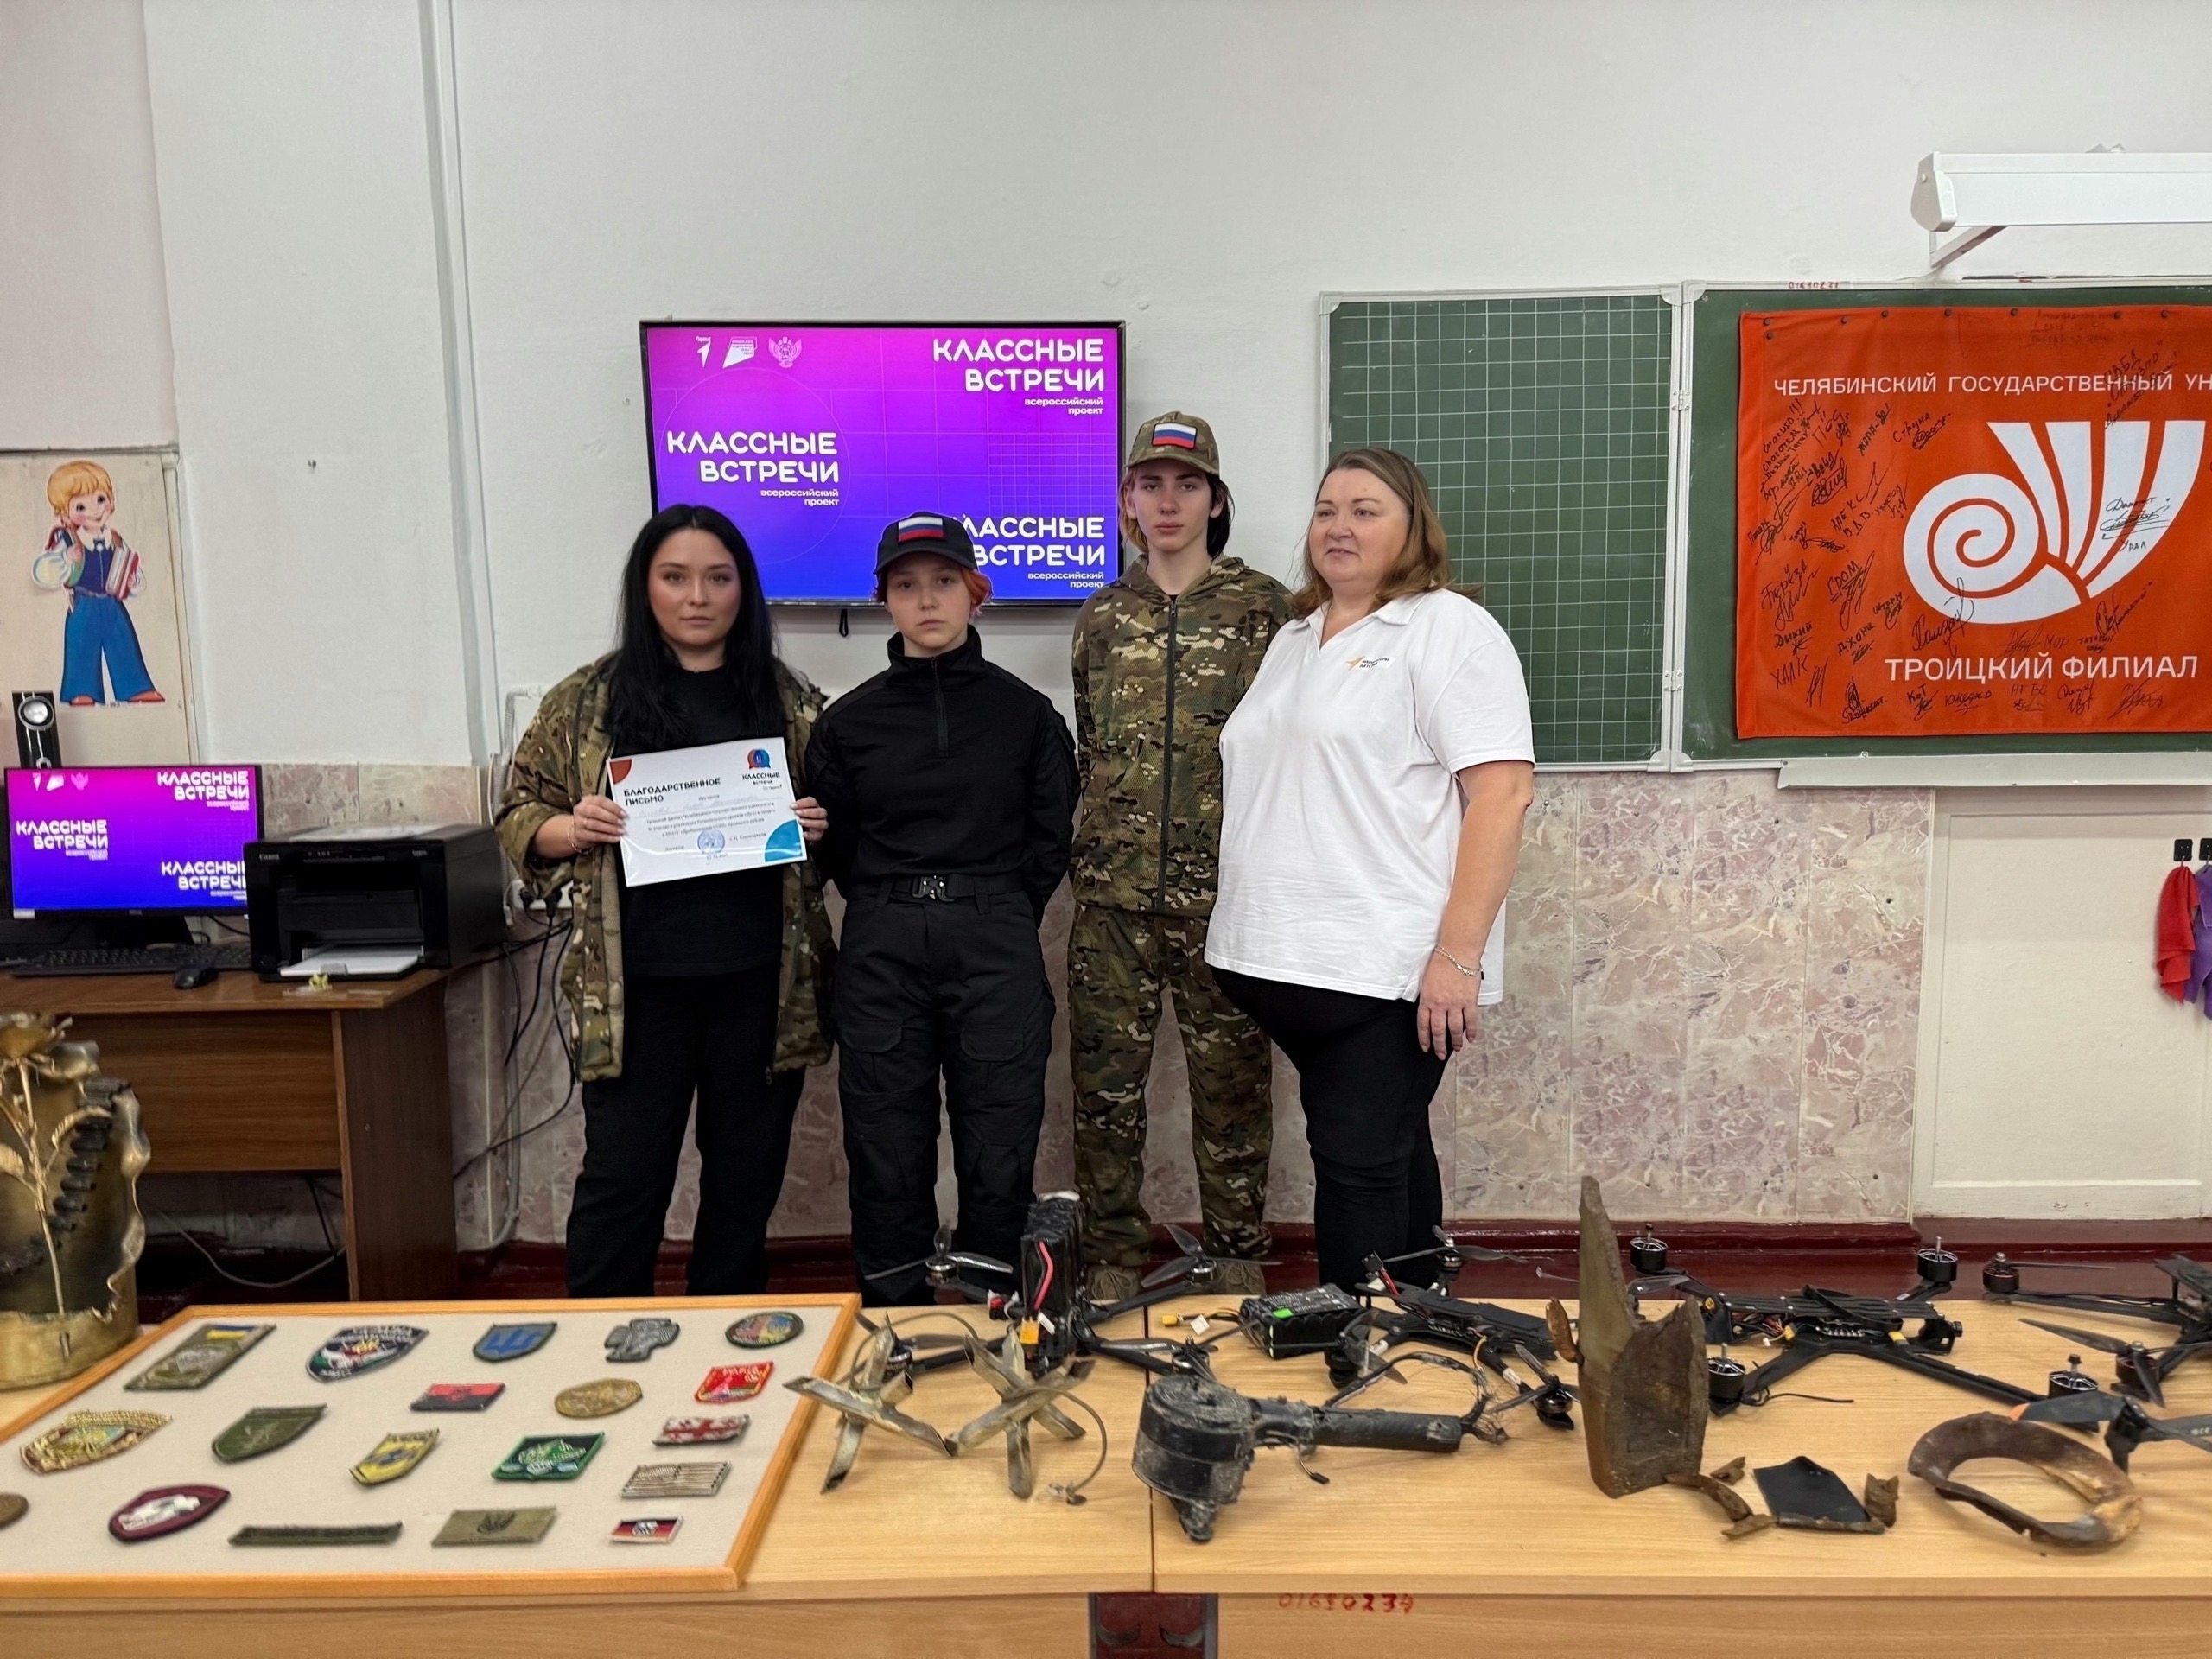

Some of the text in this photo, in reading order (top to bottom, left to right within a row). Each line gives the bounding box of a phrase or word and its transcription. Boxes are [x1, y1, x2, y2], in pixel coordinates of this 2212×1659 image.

[932, 338, 1105, 363] КЛАССНЫЕ
[964, 368, 1106, 392] ВСТРЕЧИ
[1774, 372, 1938, 397] ЧЕЛЯБИНСКИЙ
[1948, 370, 2173, 392] ГОСУДАРСТВЕННЫЙ
[1024, 397, 1104, 407] всероссийский
[1067, 407, 1104, 416] проект
[666, 431, 838, 454] КЛАССНЫЕ
[698, 461, 840, 484] ВСТРЕЧИ
[760, 488, 839, 498] всероссийский
[804, 498, 840, 506] проект
[961, 515, 1105, 539] ЛАССНЫЕ
[1027, 571, 1105, 581] всероссийский
[1069, 581, 1105, 589] проект
[1885, 652, 2198, 684] ТРОИЦКИЙ ФИЛИАЛ
[156, 770, 249, 787] КЛАССНЫЕ
[742, 772, 780, 780] КЛАССНЫЕ
[174, 785, 250, 801] ВСТРЕЧИ
[623, 777, 721, 798] БЛАГОДАРСТВЕННОЕ
[624, 794, 664, 807] ПИСЬМО
[16, 819, 108, 836] КЛАССНЫЕ
[33, 835, 109, 850] ВСТРЕЧИ
